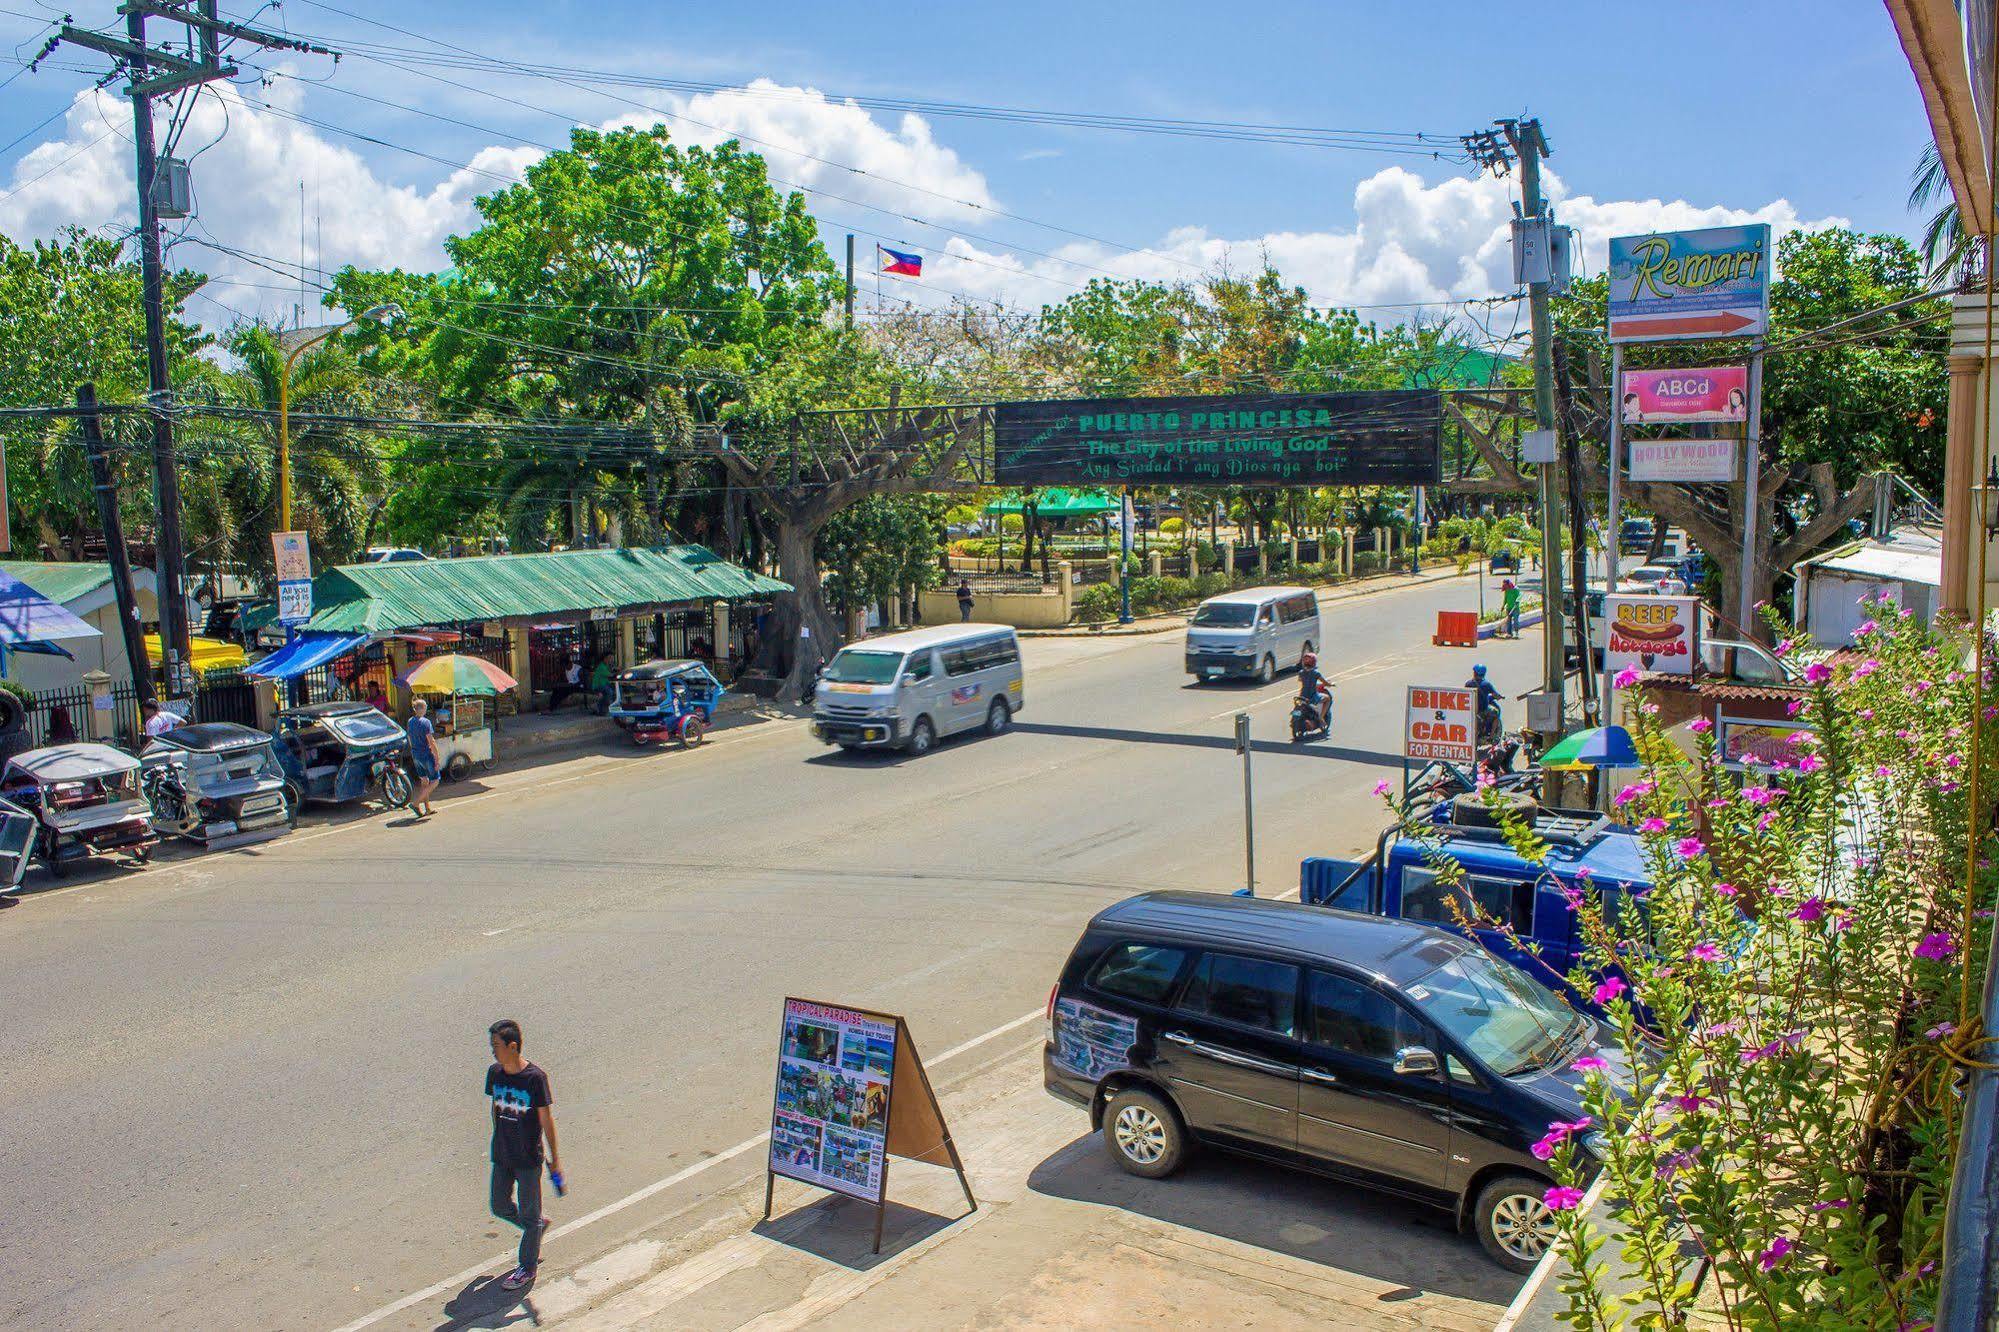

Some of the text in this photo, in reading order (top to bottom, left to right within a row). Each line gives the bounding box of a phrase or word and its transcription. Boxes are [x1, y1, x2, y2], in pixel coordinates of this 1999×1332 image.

[1629, 237, 1762, 302] Remari
[1656, 379, 1709, 396] ABCd
[1079, 408, 1332, 432] PUERTO PRINCESA
[1125, 440, 1161, 458] City
[1164, 438, 1184, 453] of
[1189, 438, 1219, 453] the
[1224, 436, 1284, 457] Living
[1194, 460, 1220, 477] ang
[1225, 458, 1267, 476] Dios
[1272, 460, 1300, 477] nga
[282, 585, 308, 596] All you
[282, 593, 300, 602] need
[1617, 604, 1679, 624] REEF
[1609, 633, 1688, 656] Hotdogs
[1412, 690, 1470, 710] BIKE
[1435, 710, 1446, 721] &
[1412, 721, 1467, 742] CAR
[1409, 743, 1471, 759] FOR RENTAL
[788, 1000, 862, 1025] TROPICAL PARADISE
[865, 1028, 875, 1037] BAY
[876, 1031, 892, 1041] TOURS
